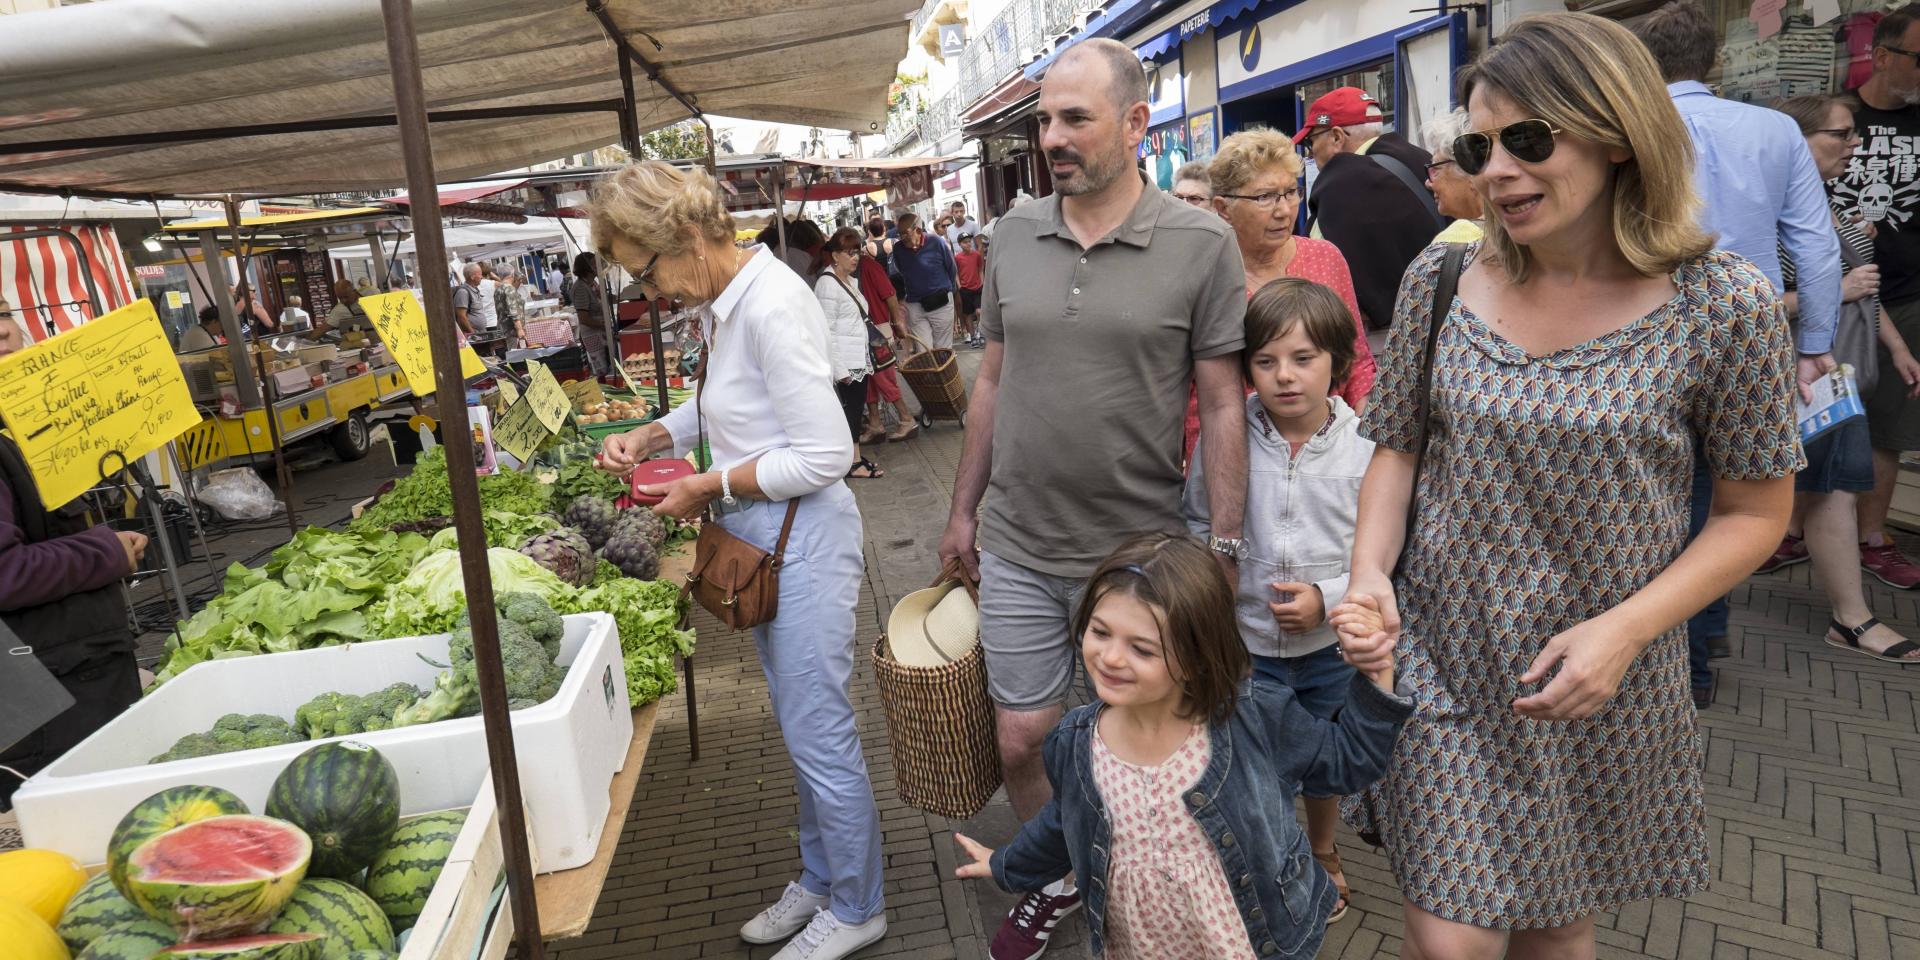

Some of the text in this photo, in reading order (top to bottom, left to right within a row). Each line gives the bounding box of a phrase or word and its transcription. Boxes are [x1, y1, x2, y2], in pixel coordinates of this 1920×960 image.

[1180, 9, 1210, 36] PAPETERIE
[944, 29, 962, 47] A
[1867, 125, 1897, 136] The
[134, 265, 165, 276] SOLDES
[17, 335, 83, 376] FRANCE
